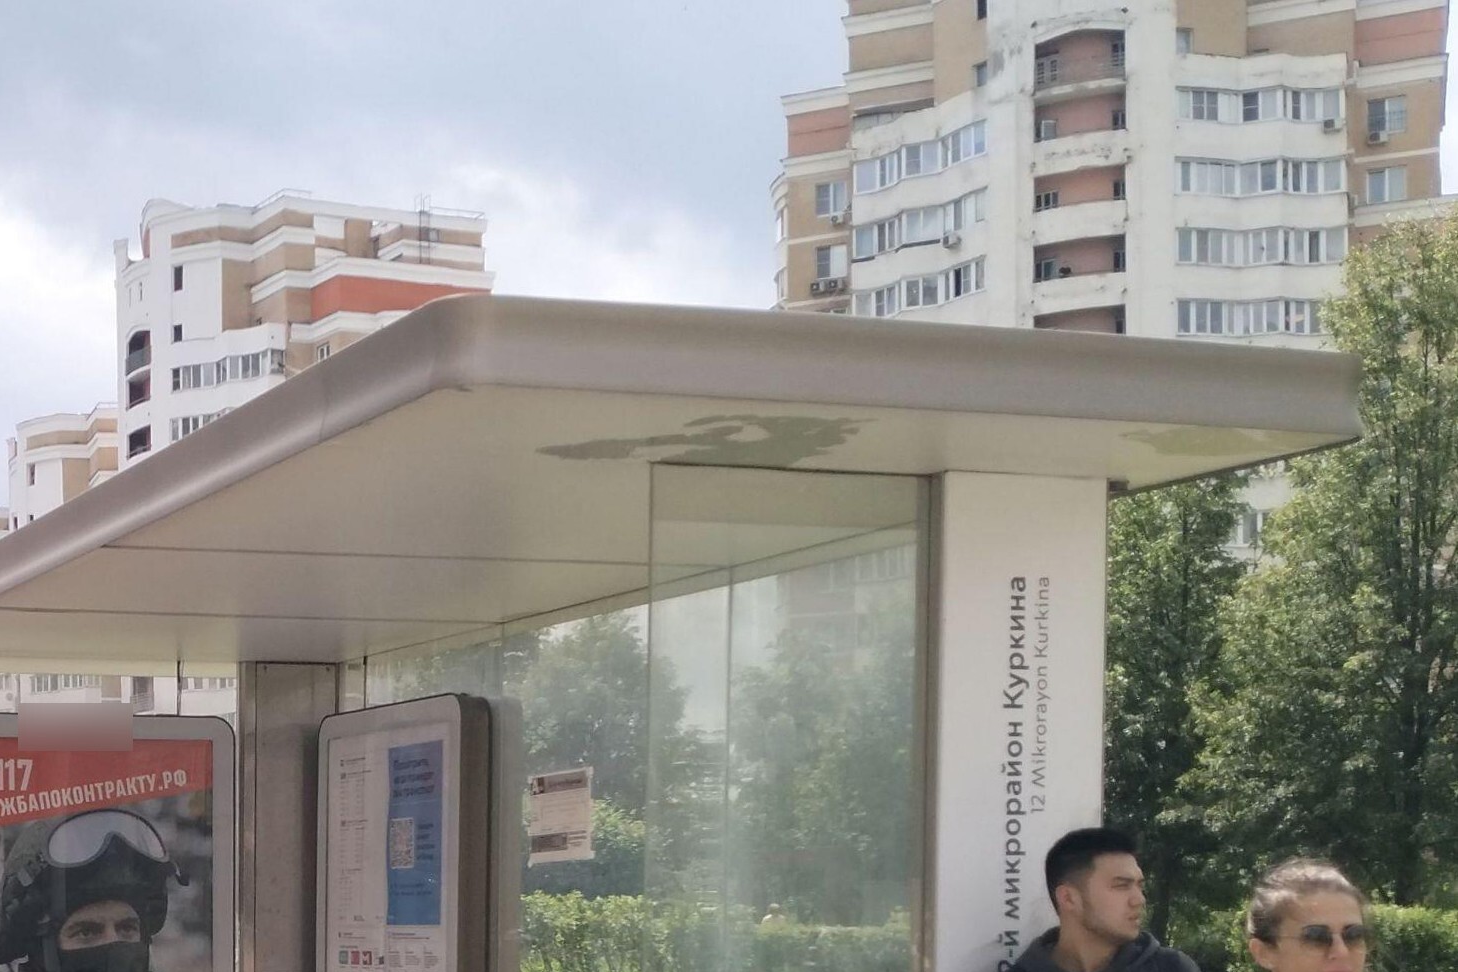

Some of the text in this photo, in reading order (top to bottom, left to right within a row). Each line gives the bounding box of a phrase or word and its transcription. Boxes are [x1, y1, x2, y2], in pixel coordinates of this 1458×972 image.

[1002, 576, 1029, 710] Куркина
[1030, 576, 1051, 814] 12 Mikrorayon Kurkina
[1000, 721, 1027, 920] микрорайон
